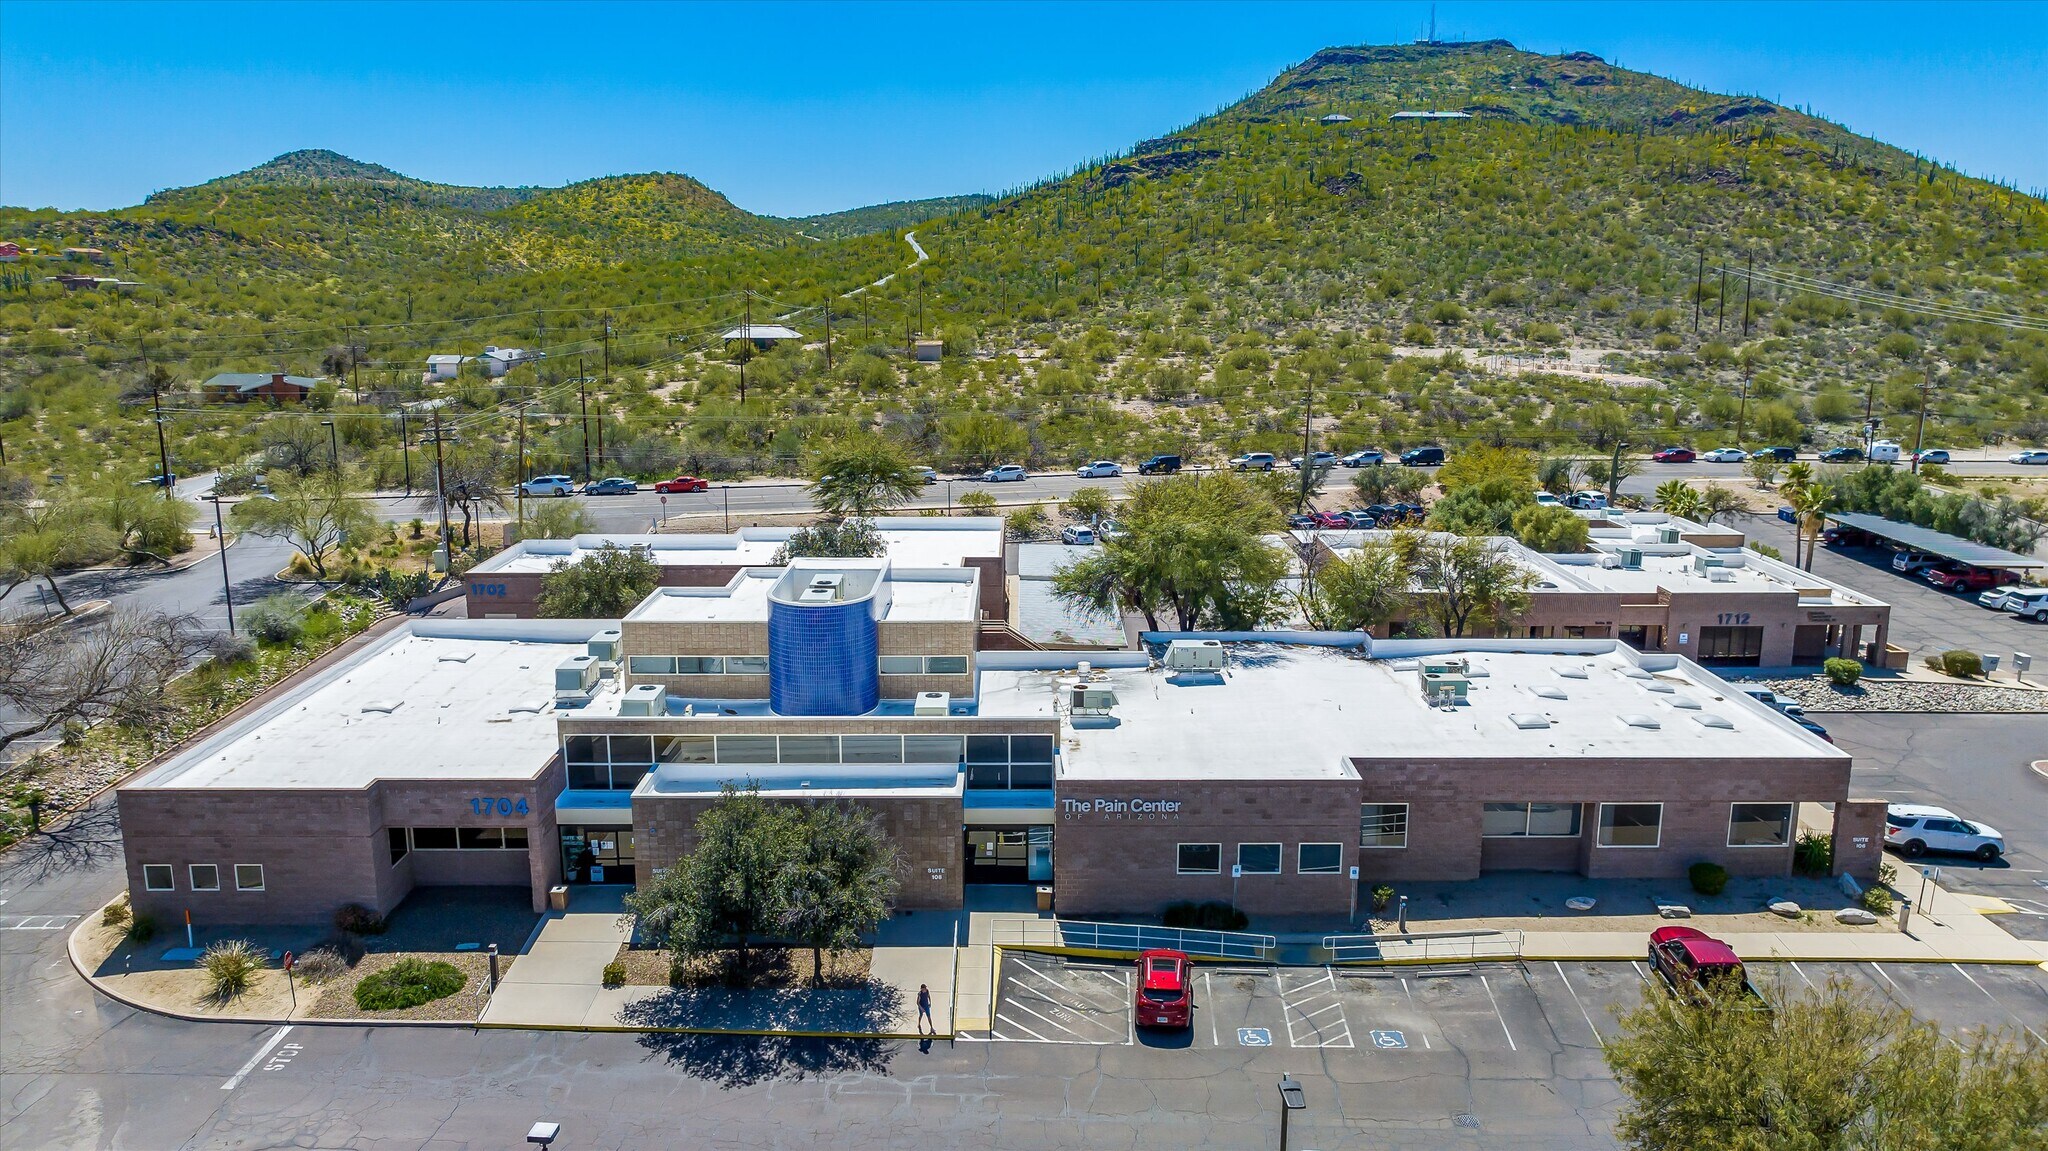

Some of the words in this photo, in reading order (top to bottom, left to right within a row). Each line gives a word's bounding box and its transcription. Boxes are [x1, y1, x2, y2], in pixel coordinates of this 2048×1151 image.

[471, 583, 507, 597] 1702
[1717, 613, 1751, 625] 1712
[470, 797, 530, 816] 1704
[1061, 798, 1091, 812] The
[1094, 798, 1128, 812] Pain
[1130, 798, 1182, 812] Center
[263, 1043, 304, 1071] STOP
